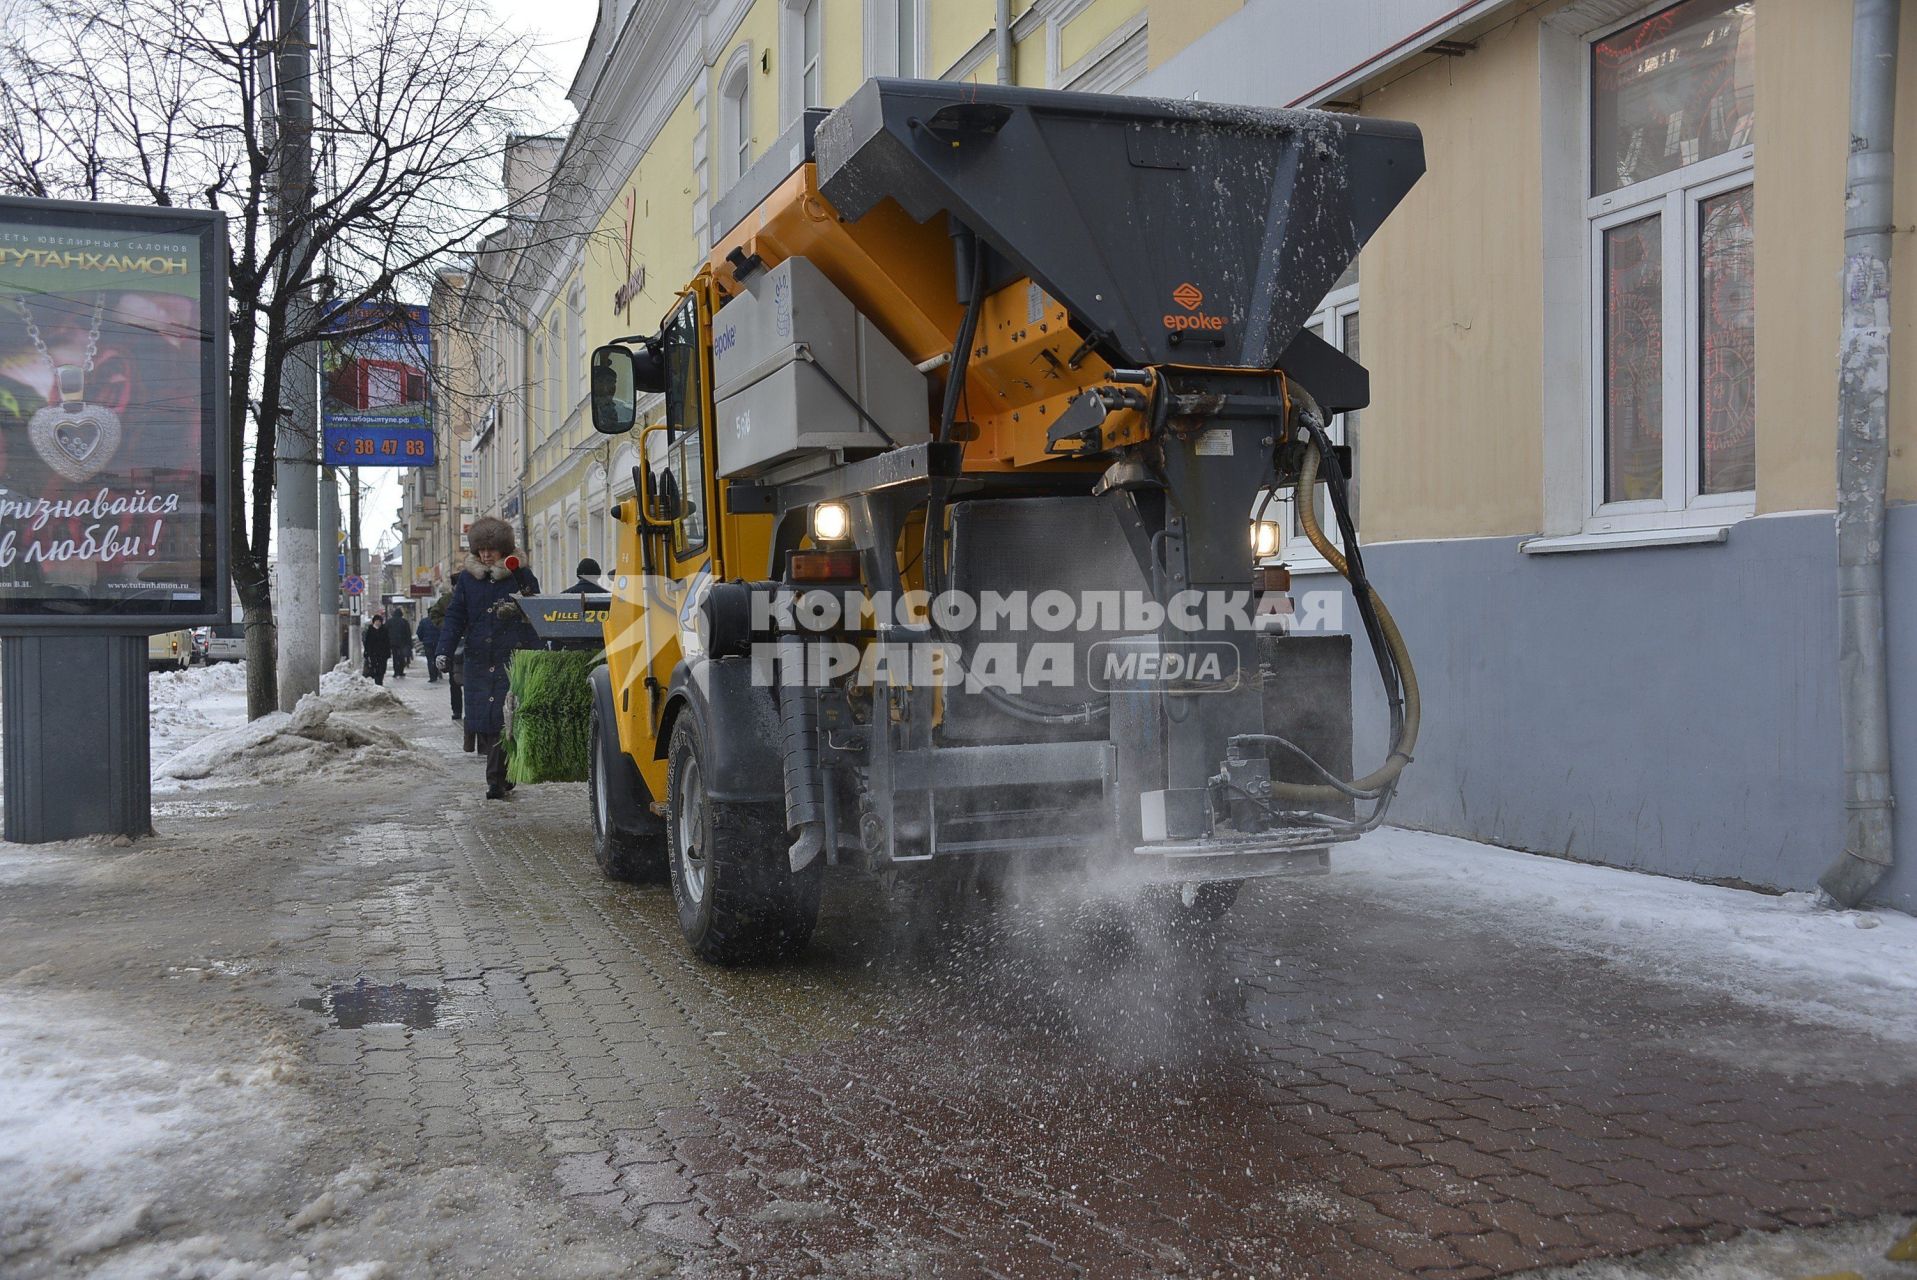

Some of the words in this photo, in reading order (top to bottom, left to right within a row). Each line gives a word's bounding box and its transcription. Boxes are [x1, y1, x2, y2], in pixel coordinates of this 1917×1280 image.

[0, 233, 29, 242] ЕТЬ
[38, 236, 119, 249] ЮВЕЛИРНЫХ
[128, 242, 187, 253] САЛОНОВ
[1163, 312, 1222, 331] epoke
[355, 439, 374, 456] 38
[381, 440, 398, 456] 47
[406, 440, 425, 456] 83
[0, 488, 179, 531] ризнавайся
[0, 531, 17, 568] в
[107, 582, 190, 590] www.tutanhamon.ru
